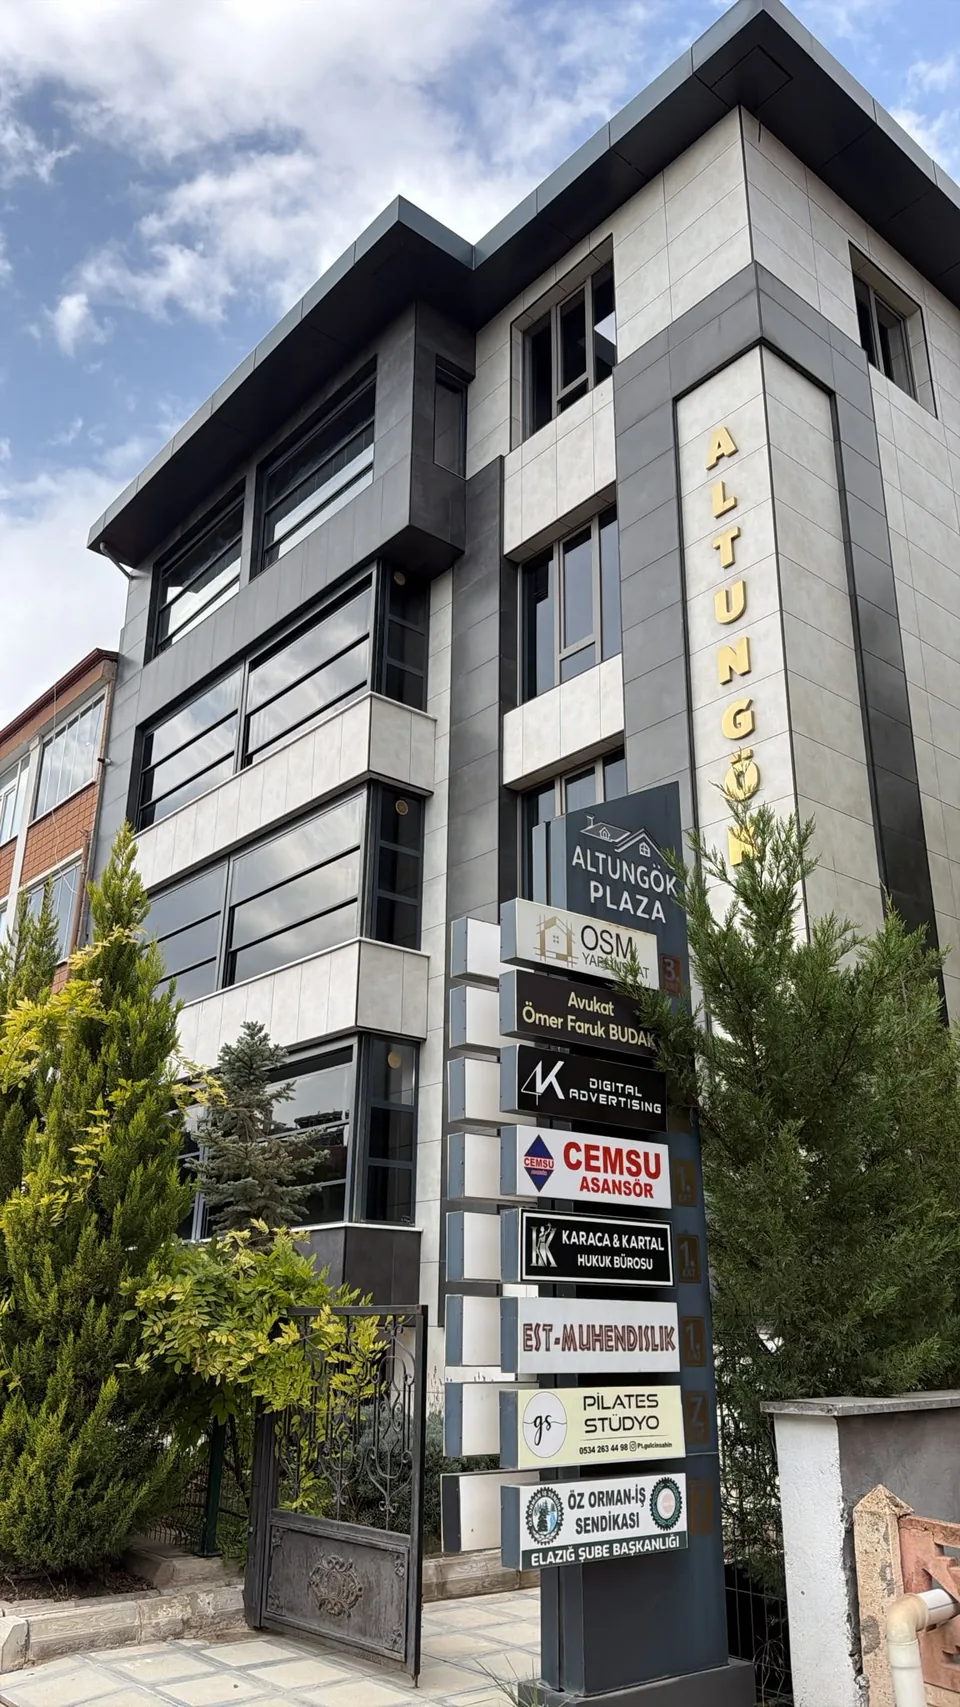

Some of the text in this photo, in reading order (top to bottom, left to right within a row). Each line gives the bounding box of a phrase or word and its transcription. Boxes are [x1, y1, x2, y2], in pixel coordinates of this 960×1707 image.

[571, 845, 679, 898] ALTUNGÖK
[589, 880, 667, 924] PLAZA
[580, 924, 633, 960] OSM
[567, 991, 615, 1017] Avukat
[522, 1001, 657, 1048] Ömer Faruk BUDAK
[588, 1077, 643, 1097] DIGITAL
[569, 1088, 662, 1114] ADVERTISING
[524, 1157, 555, 1169] CEMSU
[563, 1141, 662, 1180] CEMSU
[579, 1176, 655, 1199] ASANSÖR
[562, 1229, 665, 1251] KARACA & KARTAL
[577, 1253, 654, 1270] HUKUK BÜROSU
[583, 1392, 659, 1411] PİLATES
[584, 1413, 660, 1433] STÜDYO
[579, 1443, 628, 1455] 0534 263 44 98
[568, 1489, 585, 1510] ÖZ
[588, 1483, 646, 1508] ORMAN-İŞ
[575, 1510, 640, 1535] SENDİKASI
[531, 1535, 680, 1566] ELAZIĞ ŞUBE BAŞKANLIĞI
